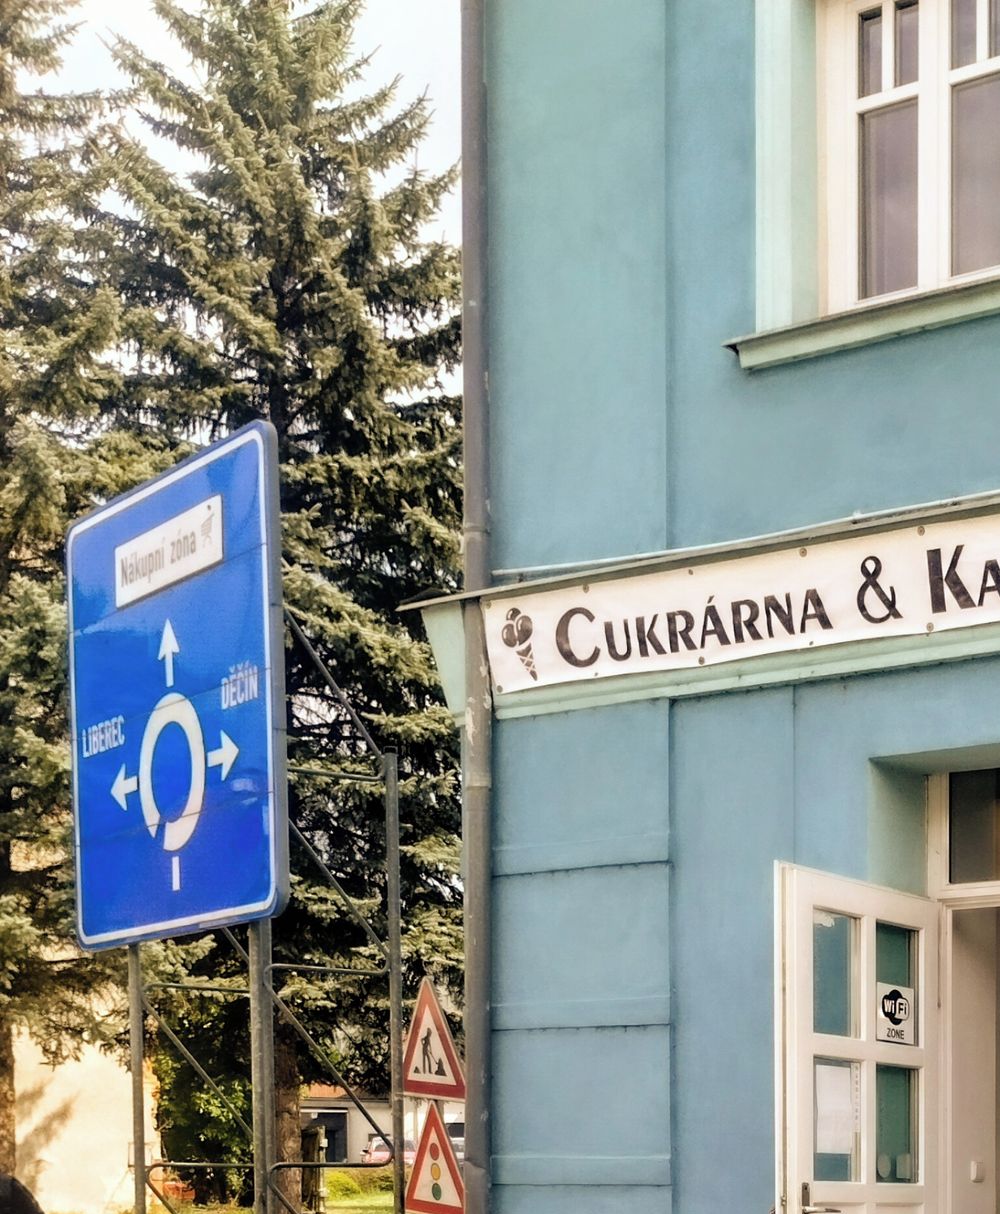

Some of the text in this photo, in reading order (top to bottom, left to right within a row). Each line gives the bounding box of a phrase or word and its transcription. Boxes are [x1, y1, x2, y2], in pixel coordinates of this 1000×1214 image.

[120, 528, 197, 588] Nákupní zóna
[555, 587, 834, 668] CUKRÁRNA
[857, 555, 904, 624] &
[221, 660, 259, 710] DĚČÍN
[82, 715, 126, 758] LIBEREC
[886, 1027, 905, 1040] ZONE
